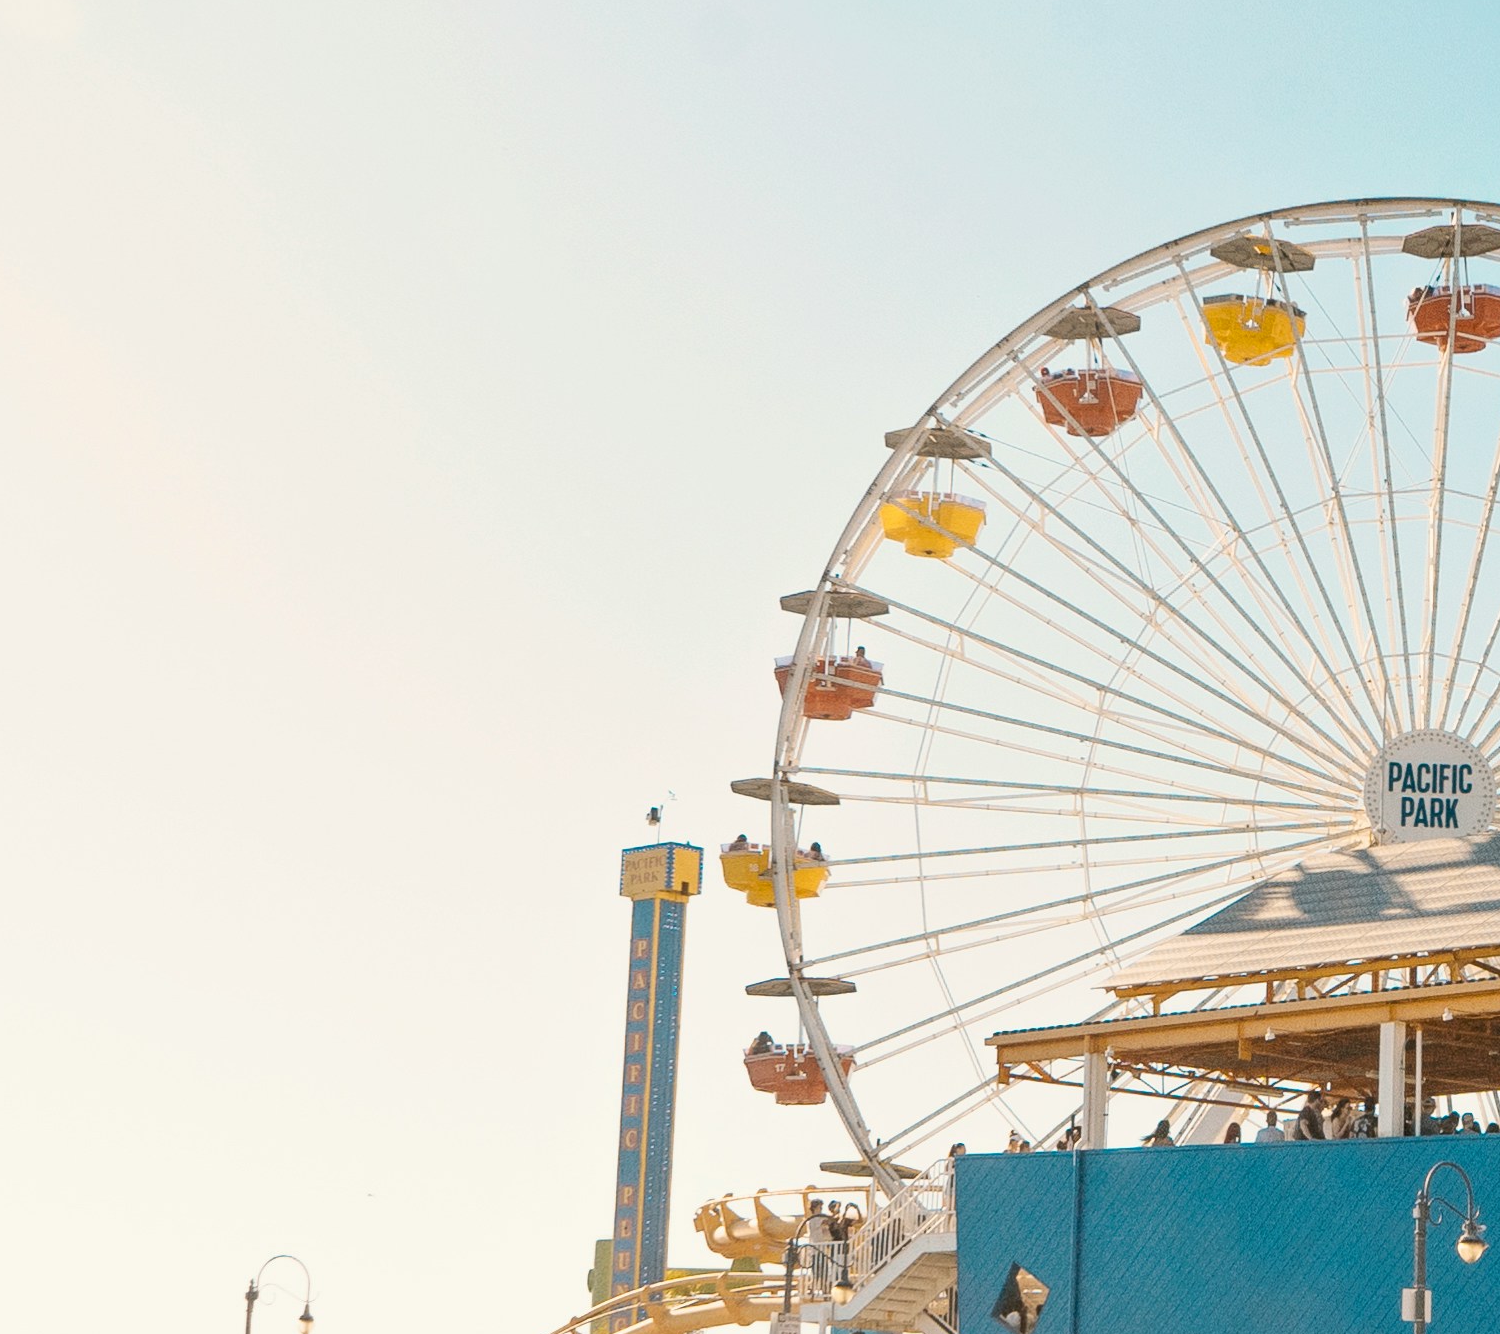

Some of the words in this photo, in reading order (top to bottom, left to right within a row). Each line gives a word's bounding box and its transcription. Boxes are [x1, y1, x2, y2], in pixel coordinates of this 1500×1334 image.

[1388, 762, 1473, 794] PACIFIC
[1400, 797, 1459, 828] PARK
[625, 855, 665, 871] PACIFIC
[630, 871, 659, 885] PARK
[625, 940, 648, 1147] PACIFIC
